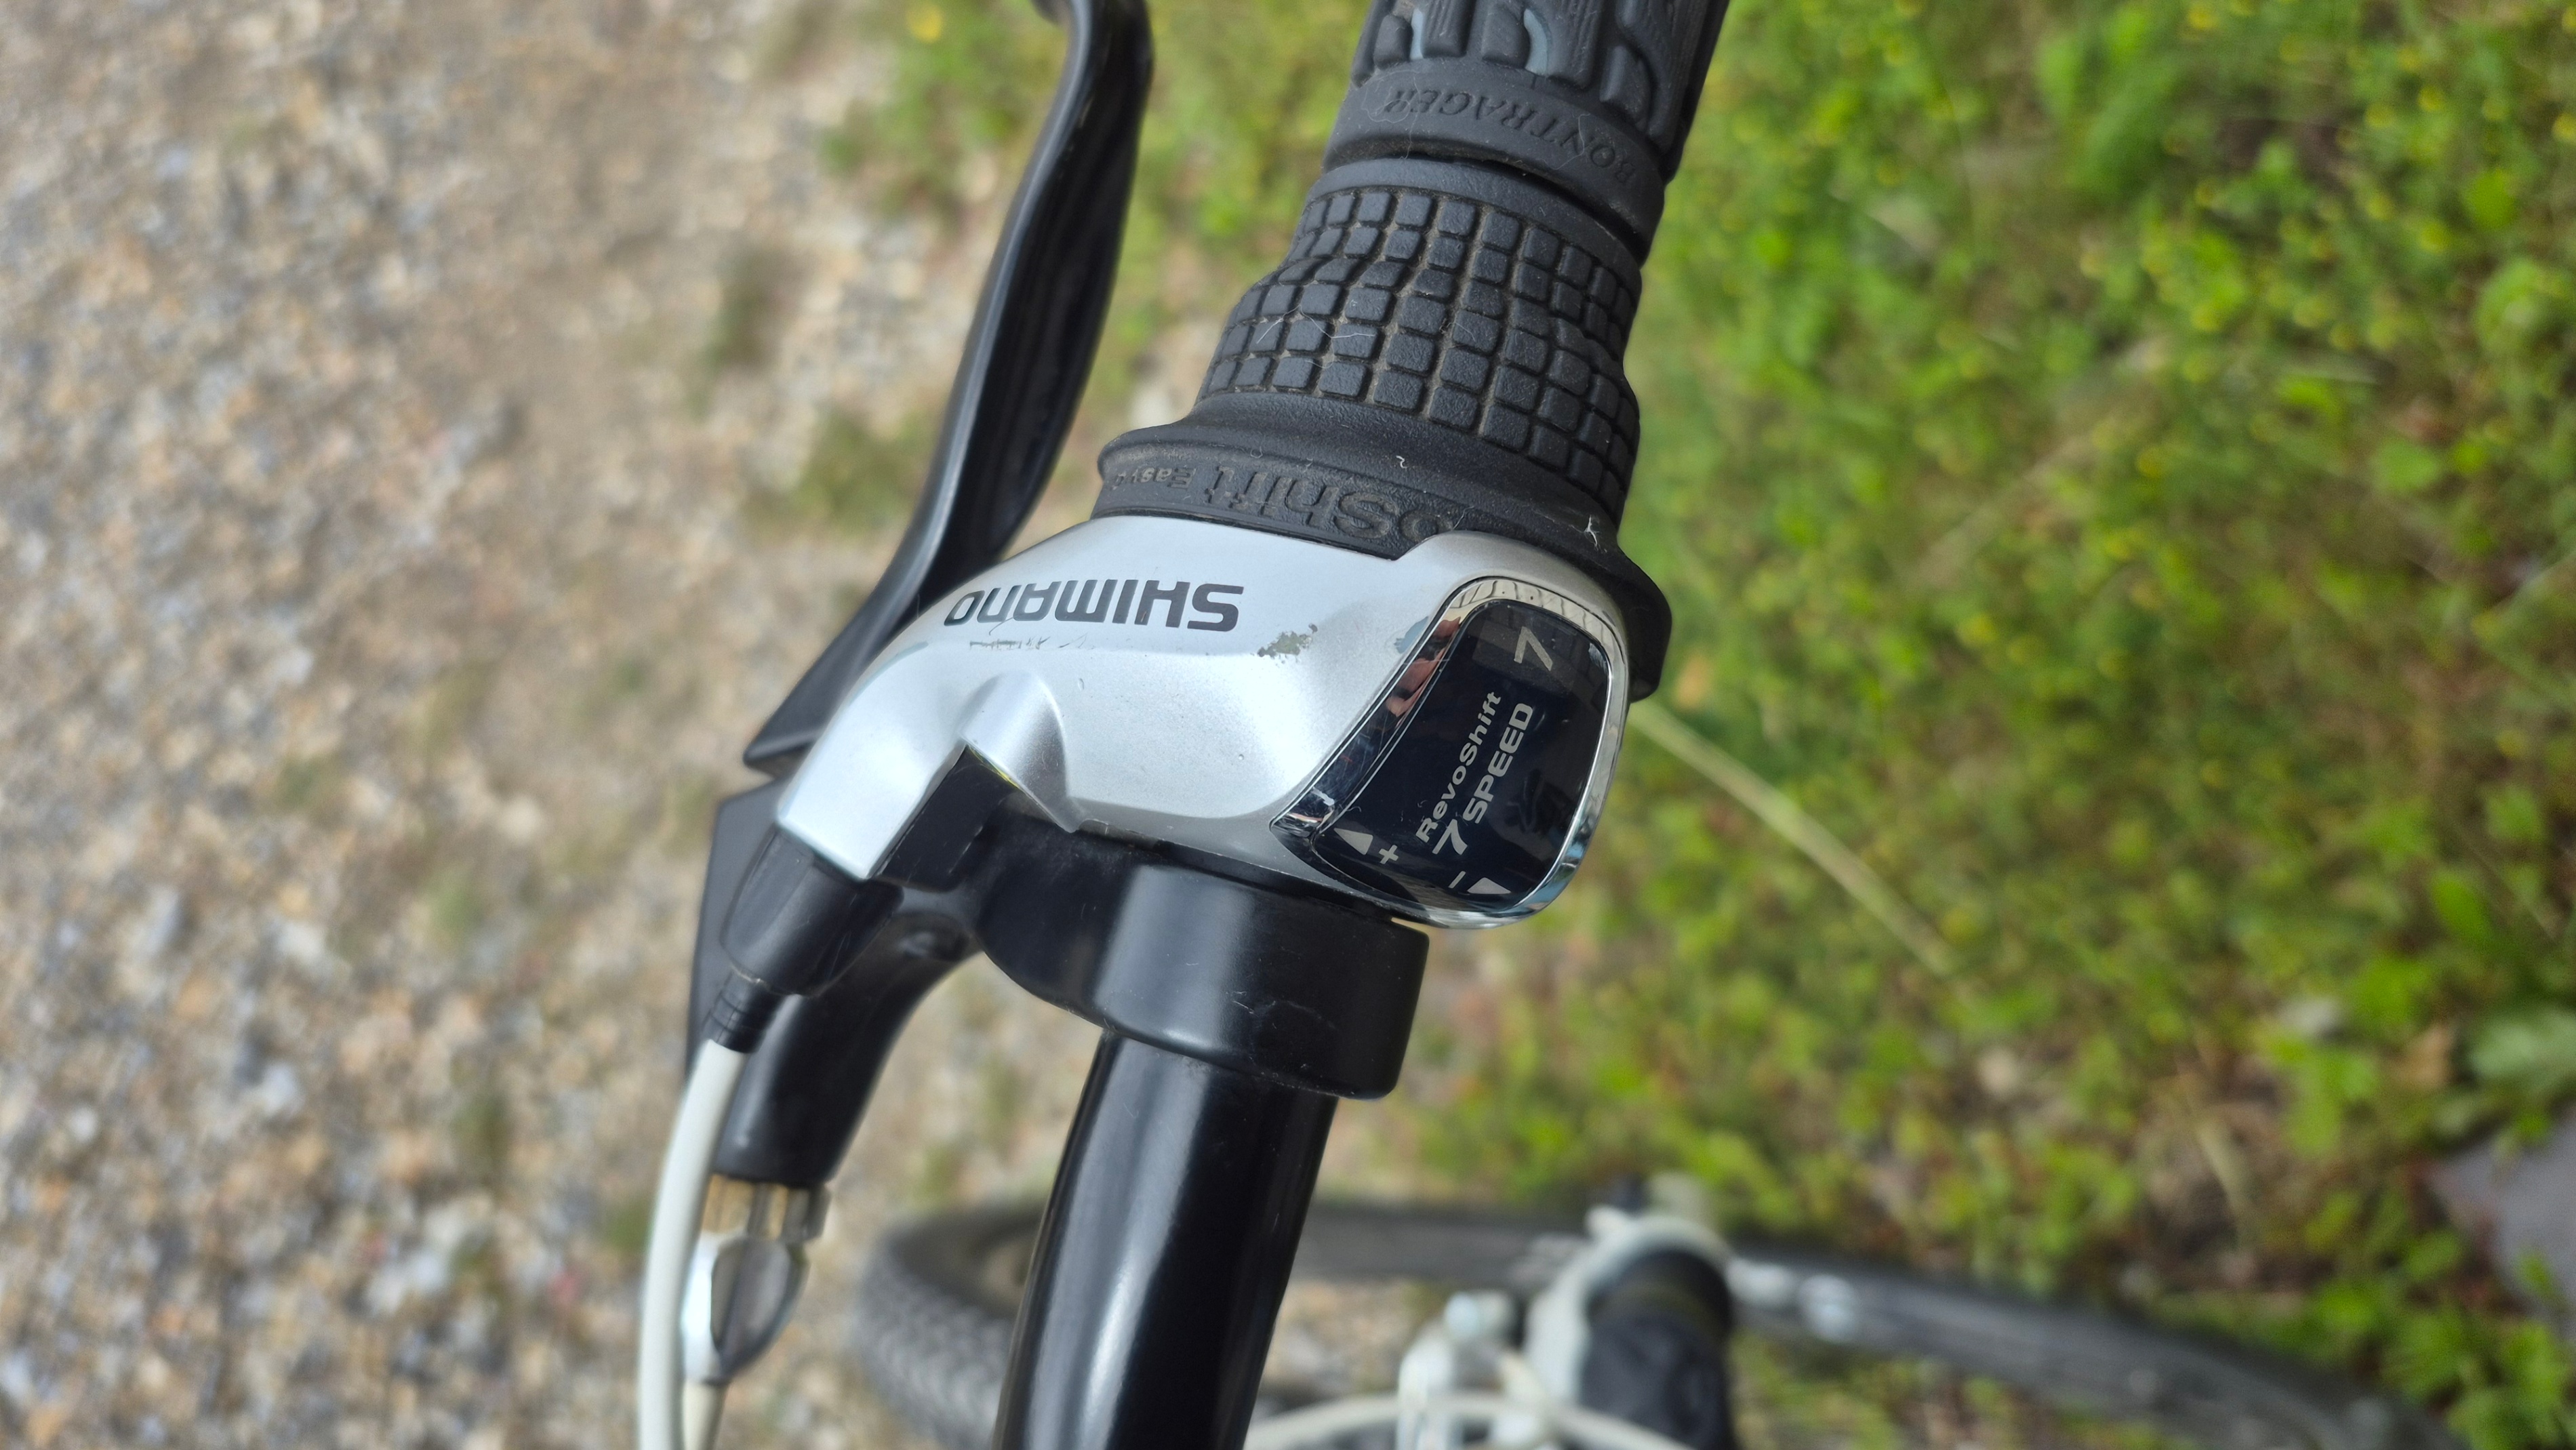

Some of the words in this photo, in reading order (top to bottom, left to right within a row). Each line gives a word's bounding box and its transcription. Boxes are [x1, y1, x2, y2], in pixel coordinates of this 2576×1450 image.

[1384, 89, 1636, 184] BONTRAGER
[944, 579, 1245, 632] SHIMANO
[1513, 625, 1554, 672] 7
[1415, 691, 1502, 843] RevoShift
[1432, 818, 1468, 855] 7
[1462, 703, 1533, 824] SPEED
